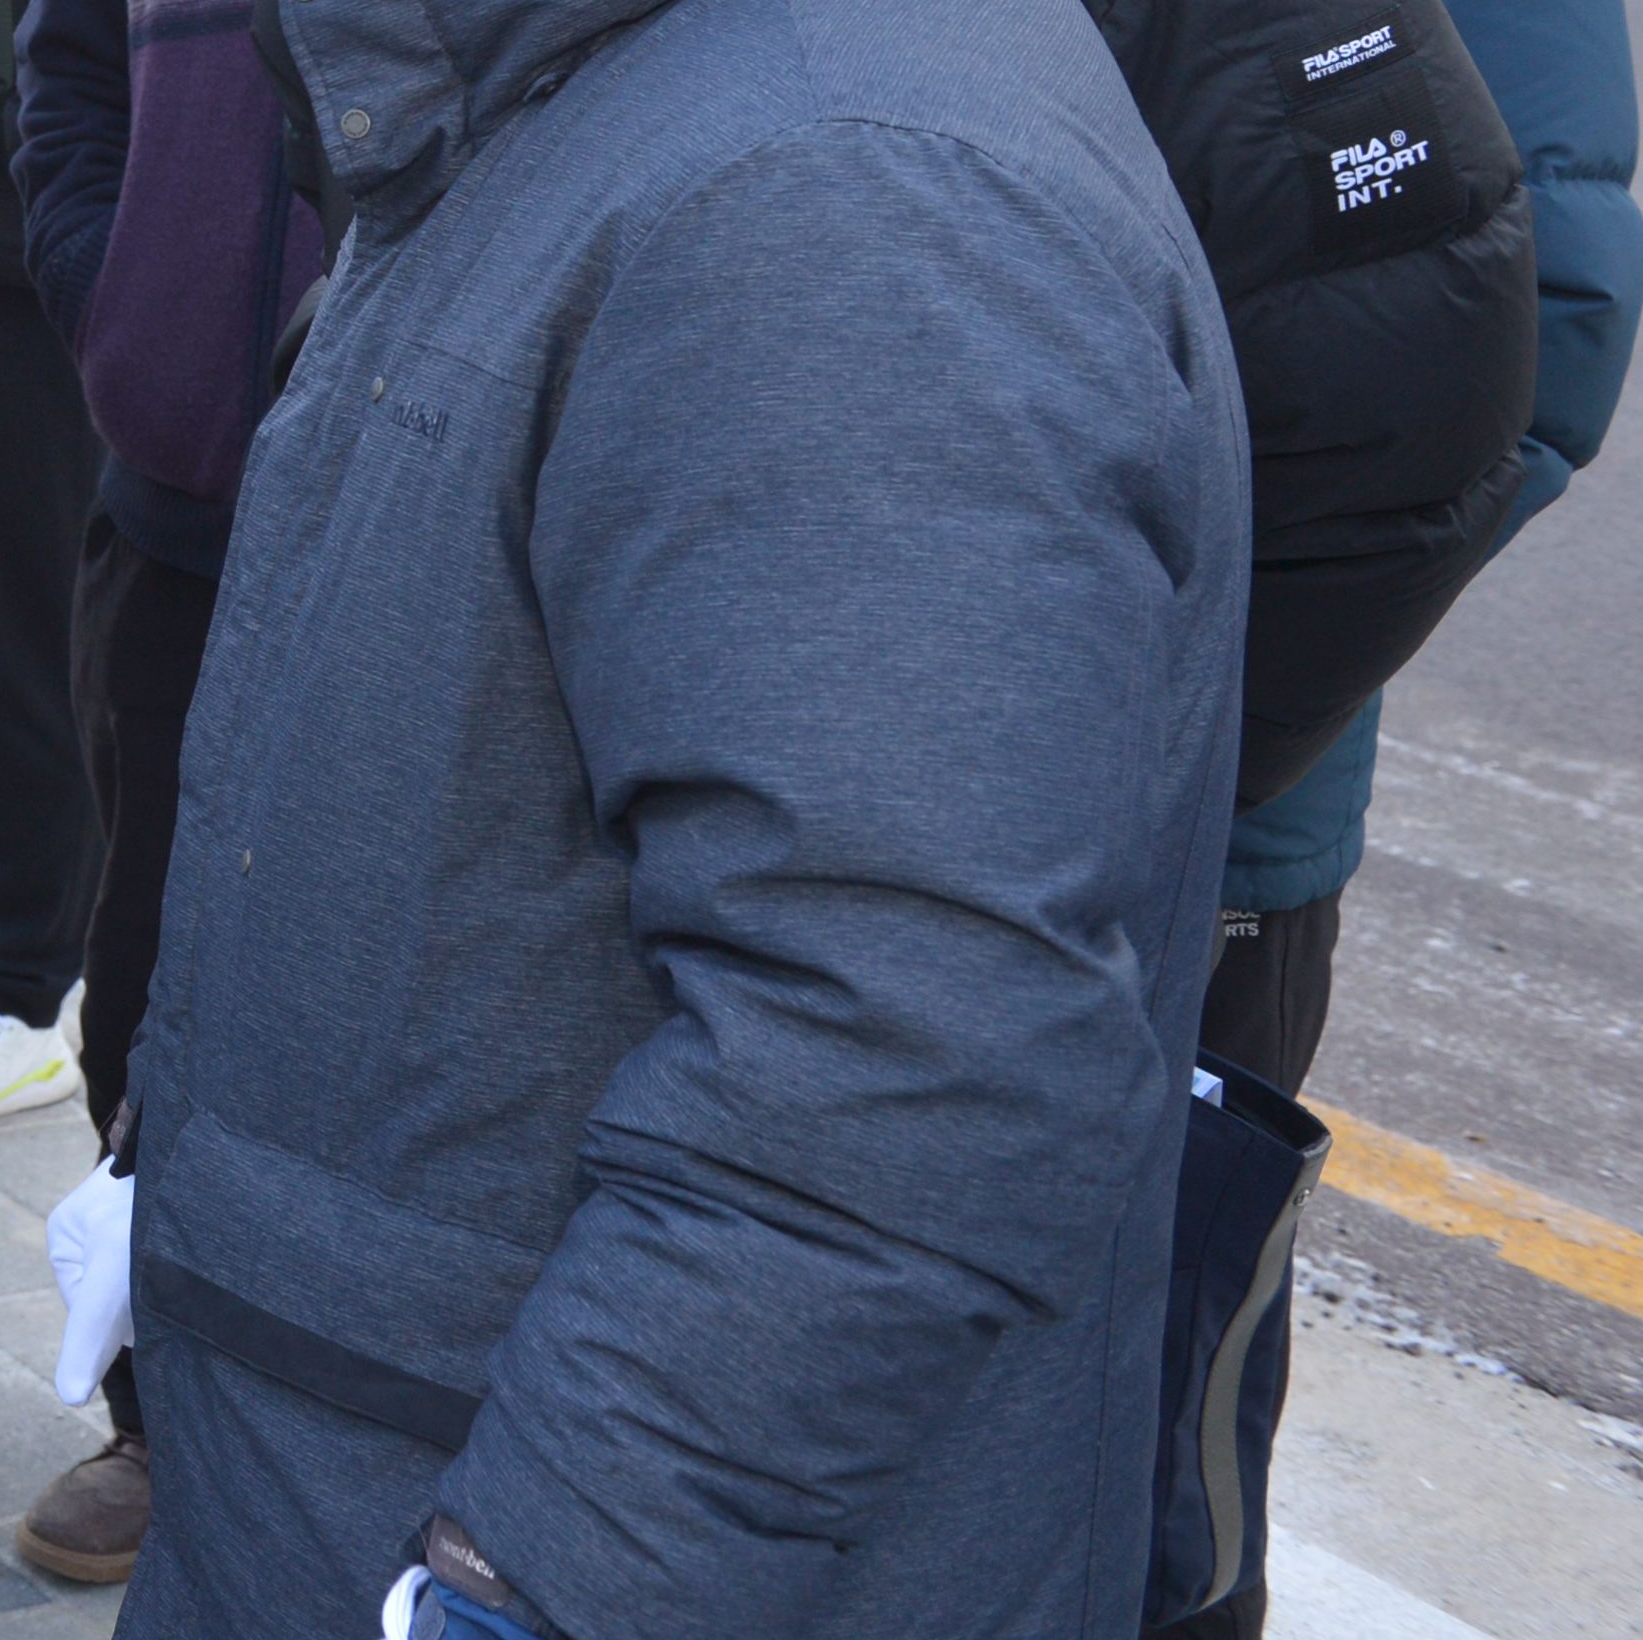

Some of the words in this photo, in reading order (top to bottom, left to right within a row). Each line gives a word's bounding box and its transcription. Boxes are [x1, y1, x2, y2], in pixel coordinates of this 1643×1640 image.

[1338, 25, 1391, 57] SPORT
[1306, 40, 1397, 81] INTERNATIONAL
[1335, 140, 1428, 190] SPORT
[1338, 178, 1402, 212] INT.
[1224, 922, 1260, 937] RTS
